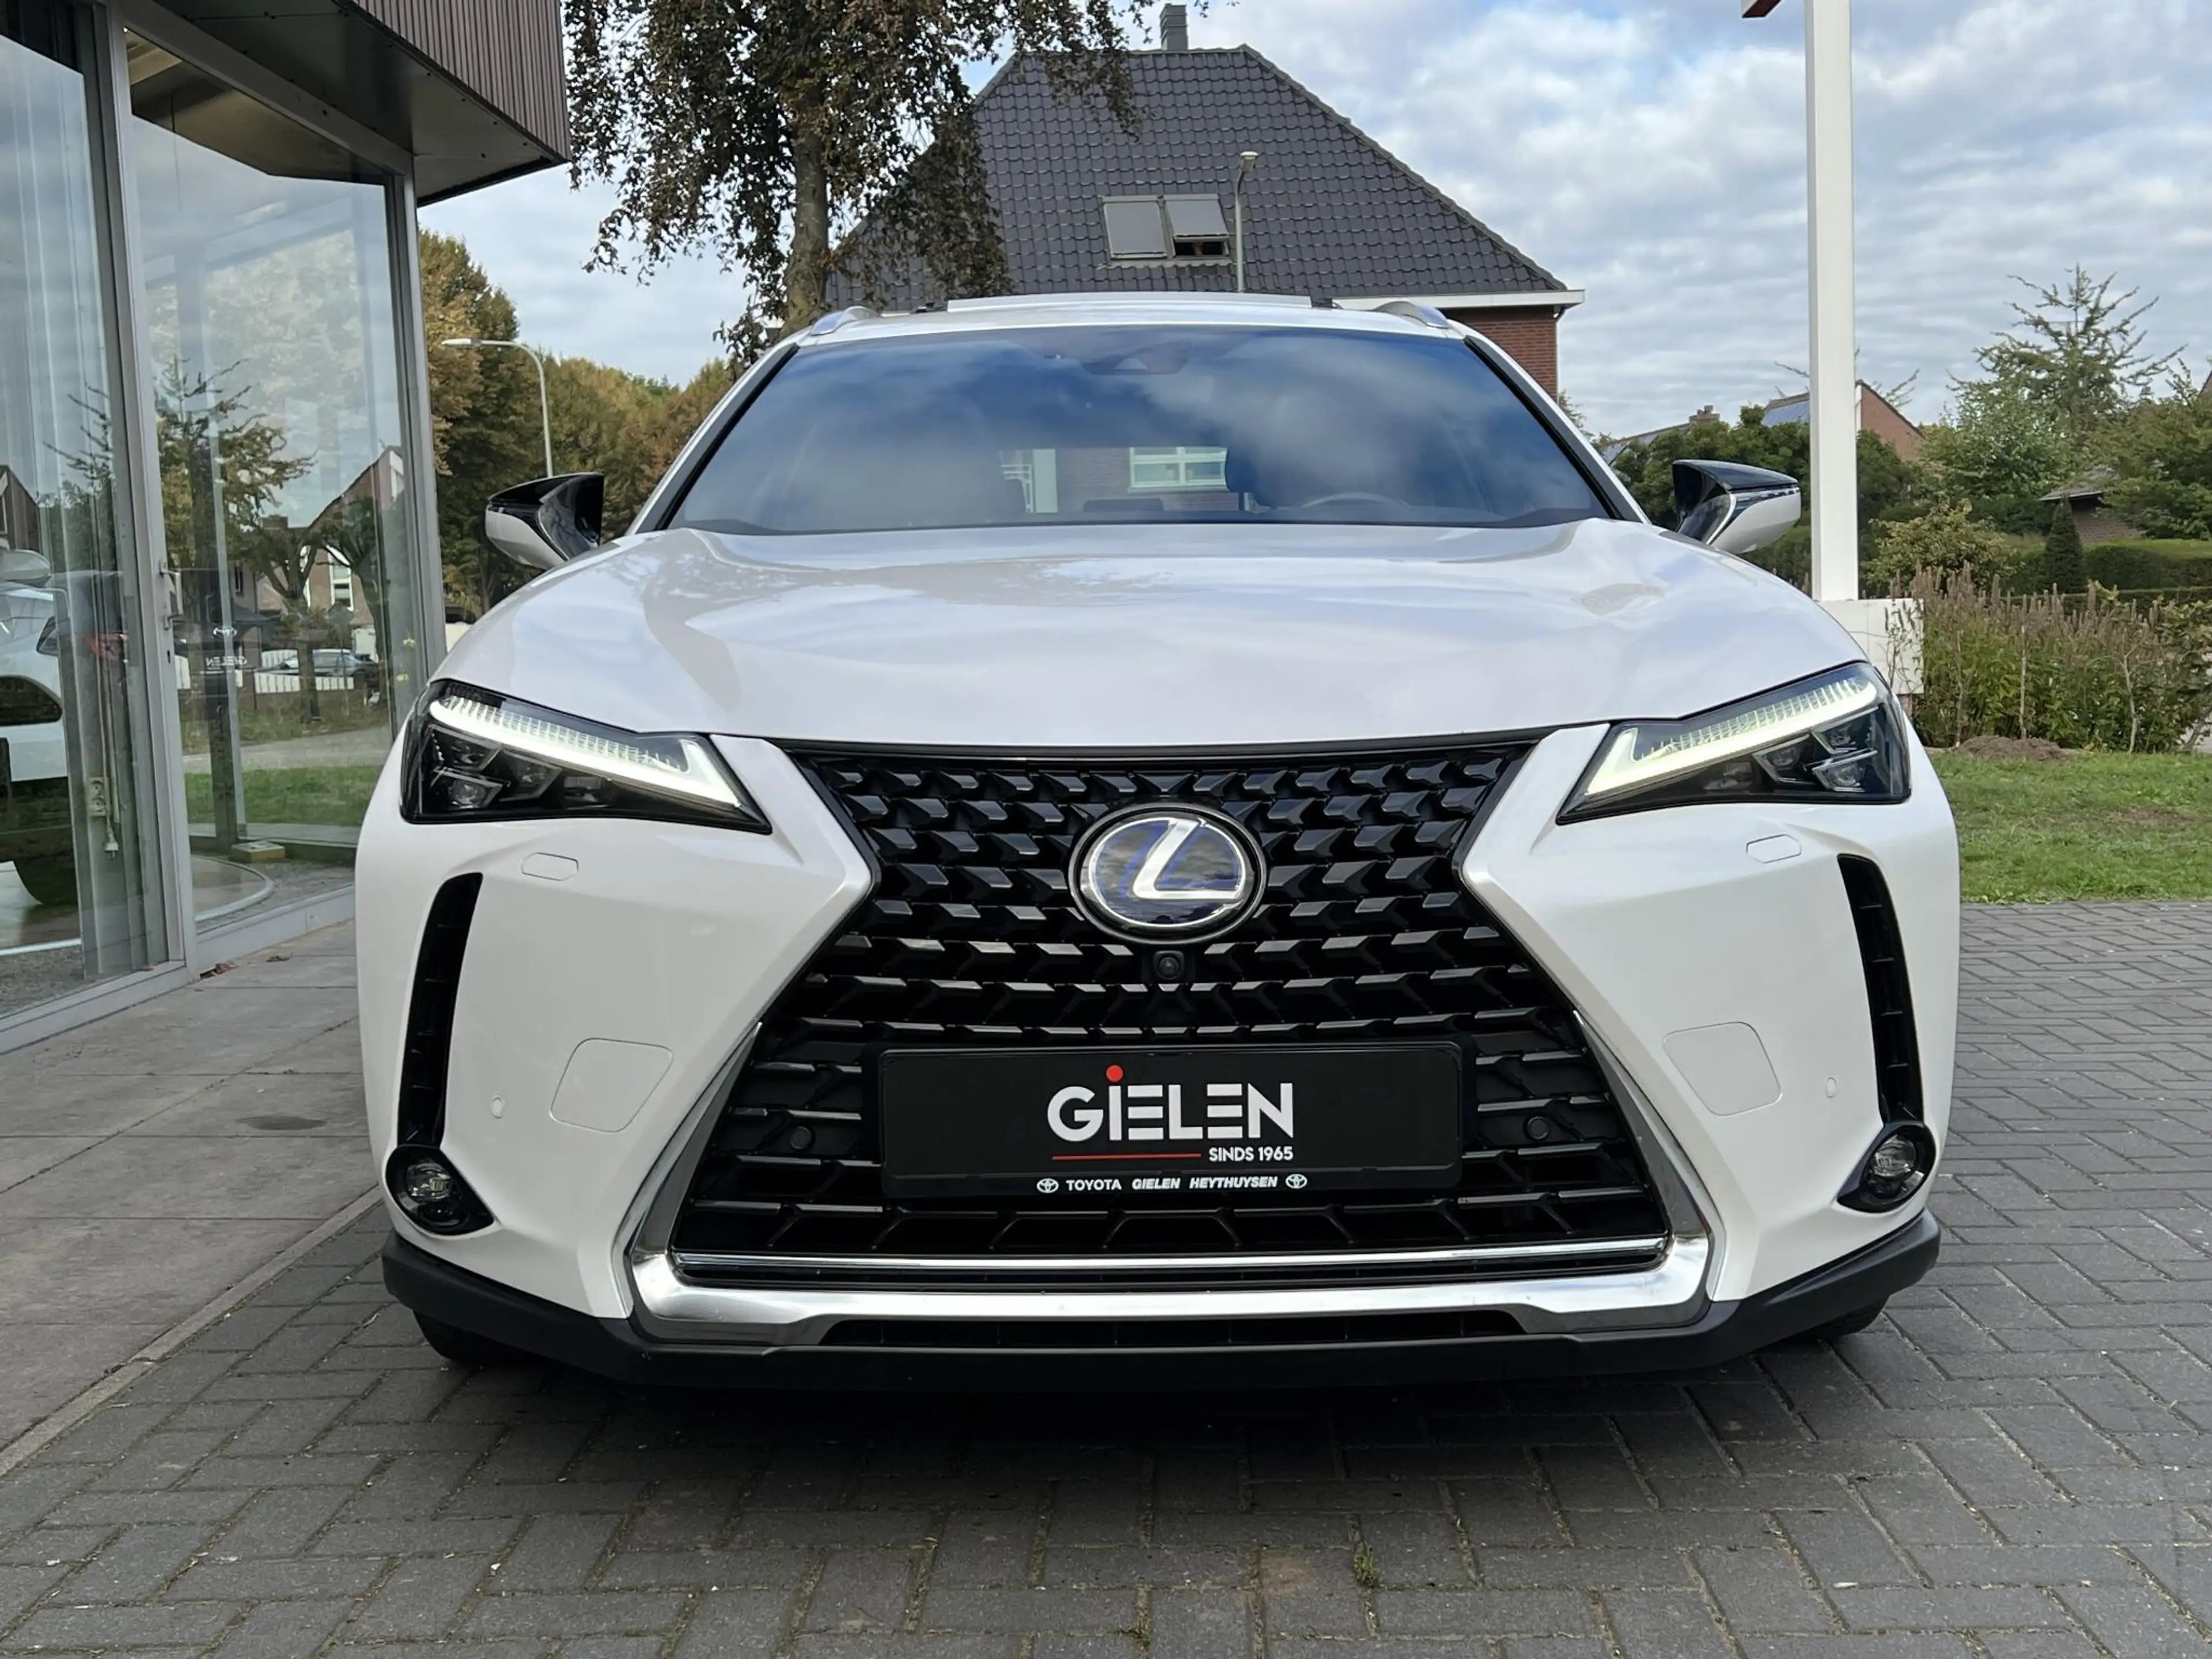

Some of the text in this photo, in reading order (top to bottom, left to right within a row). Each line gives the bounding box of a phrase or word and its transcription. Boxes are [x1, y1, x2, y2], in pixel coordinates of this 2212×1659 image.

[1209, 1146, 1294, 1162] SINDS 1965
[1066, 1176, 1278, 1191] TOYOTA GIELEN HEYTHUYSEN
